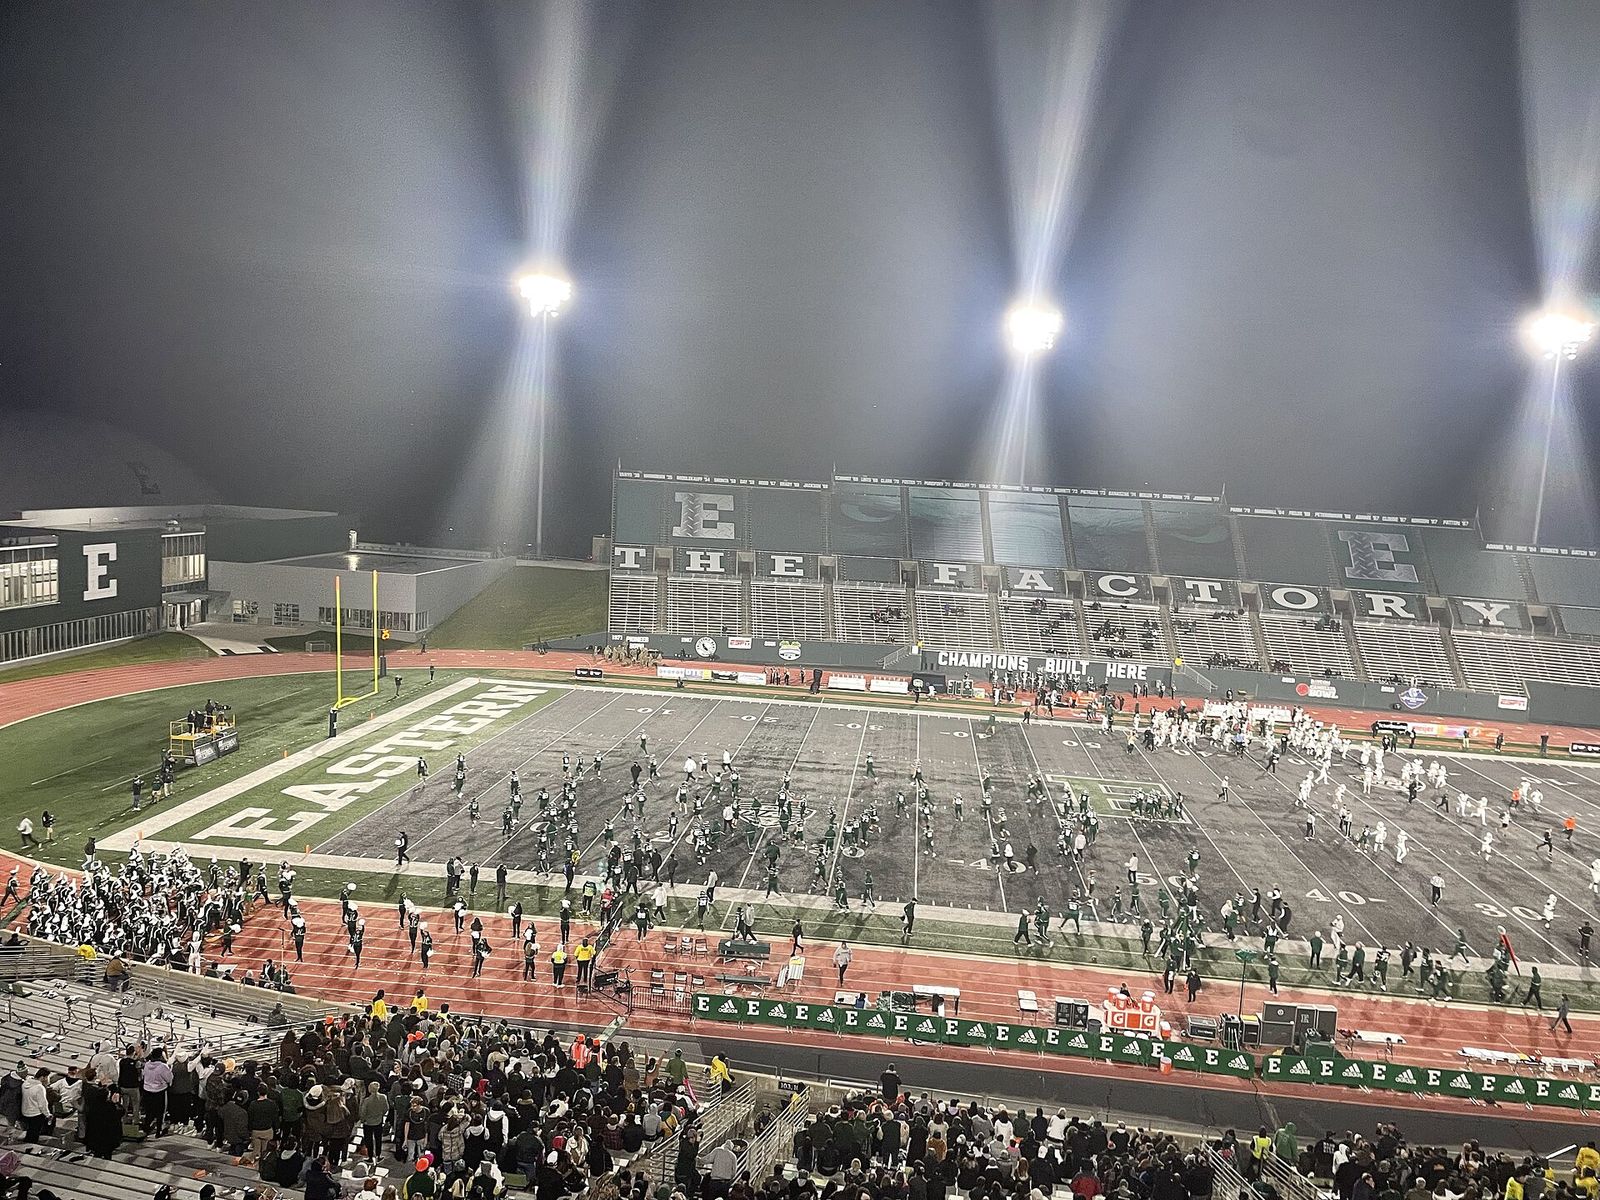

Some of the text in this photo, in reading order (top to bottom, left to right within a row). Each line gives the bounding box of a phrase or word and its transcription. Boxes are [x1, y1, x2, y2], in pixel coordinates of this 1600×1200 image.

[672, 492, 736, 540] E
[1337, 530, 1419, 583] E
[83, 542, 117, 601] E
[938, 651, 1148, 680] CHAMPIONS BUILT HERE
[190, 684, 549, 846] EASTERN
[697, 997, 710, 1011] E
[746, 1001, 760, 1015] E
[795, 1006, 809, 1020] E
[845, 1011, 858, 1025] E
[1113, 1013, 1124, 1024] G
[894, 1015, 908, 1030] E
[945, 1020, 959, 1035] E
[1143, 1015, 1154, 1026] G
[996, 1026, 1010, 1040] E
[1046, 1031, 1060, 1044] E
[1099, 1037, 1114, 1051] E
[1150, 1042, 1165, 1057] E
[1205, 1050, 1219, 1065] E
[1267, 1058, 1282, 1072] E
[1320, 1061, 1334, 1075] E
[1372, 1064, 1387, 1080] E
[1427, 1071, 1442, 1085] E
[1481, 1076, 1496, 1091] E
[1536, 1081, 1550, 1096] E
